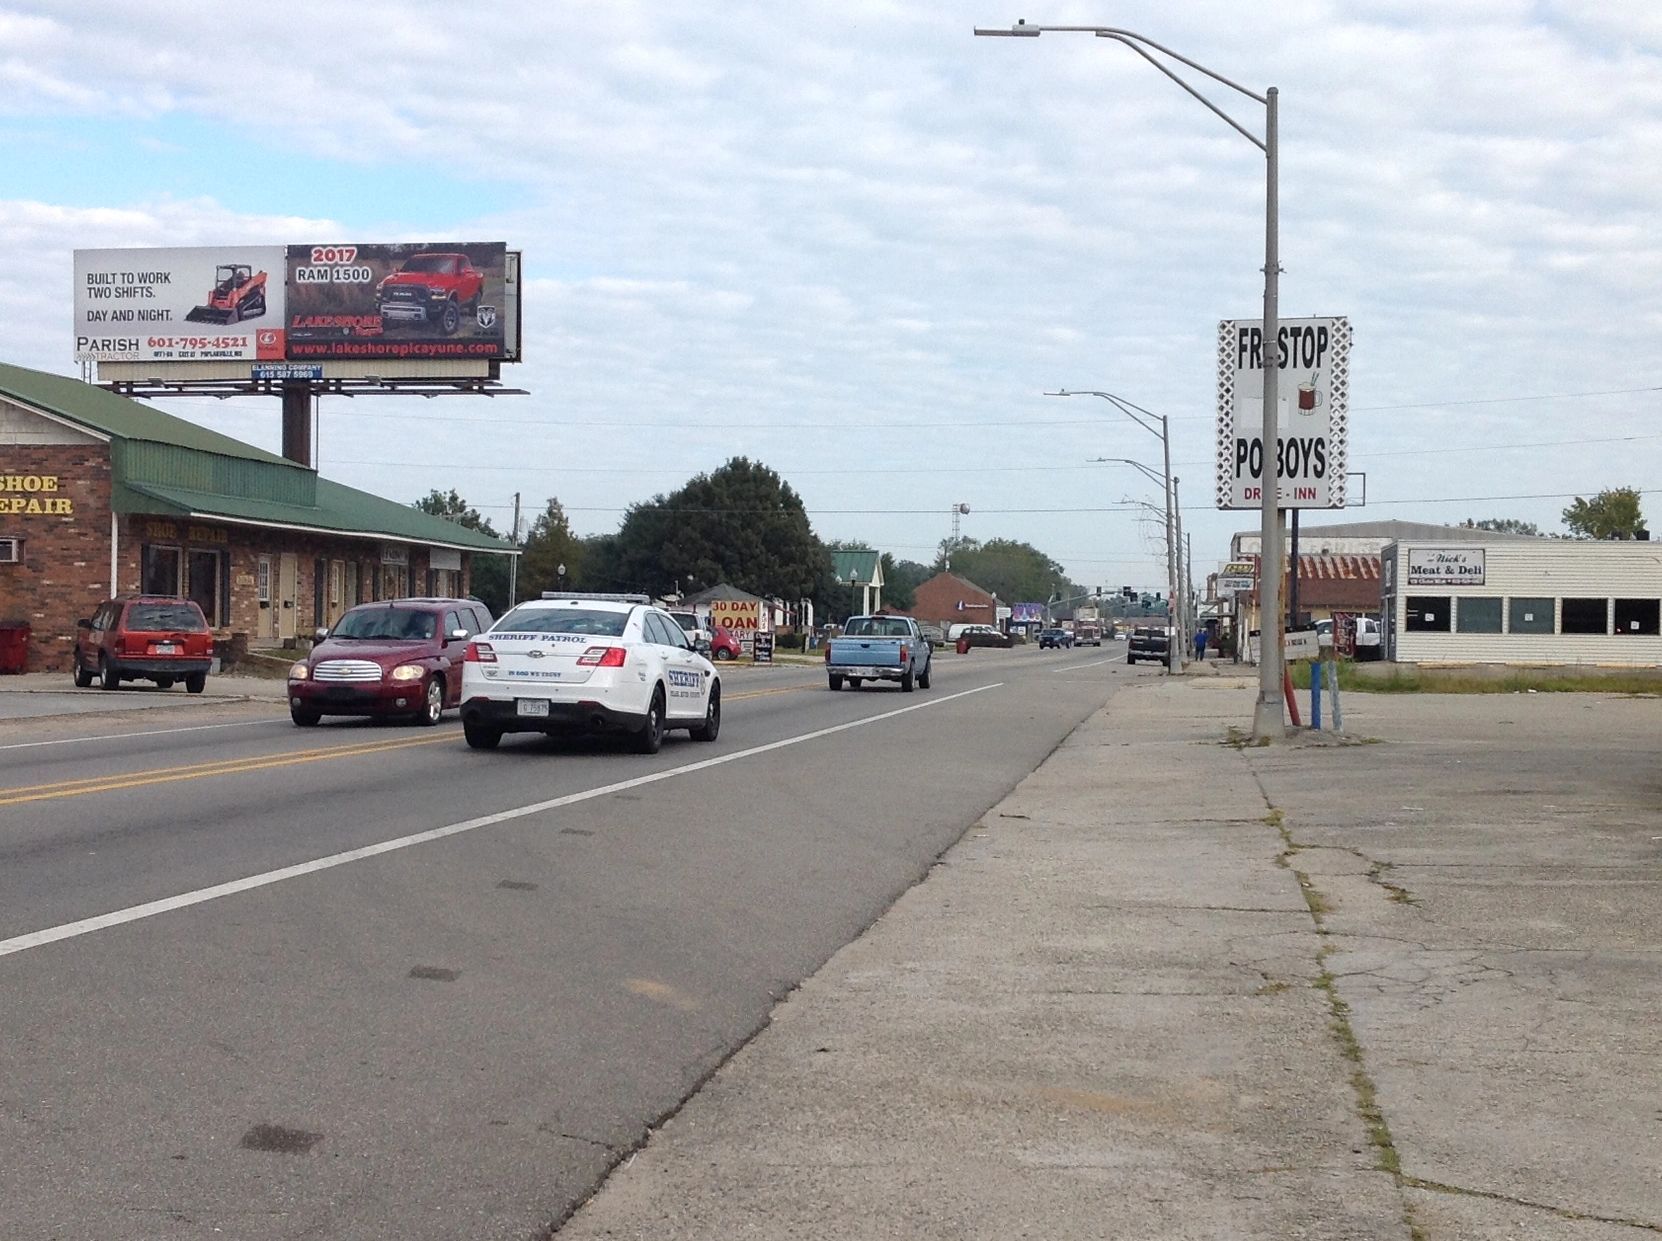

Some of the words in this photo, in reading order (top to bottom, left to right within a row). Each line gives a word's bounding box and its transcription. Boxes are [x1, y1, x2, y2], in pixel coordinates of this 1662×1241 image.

[312, 247, 357, 263] 2017
[87, 272, 117, 284] BUILT
[120, 272, 134, 284] TO
[138, 271, 171, 284] WORK
[297, 268, 329, 281] RAM
[334, 267, 371, 281] 1500
[87, 286, 112, 298] TWO
[114, 286, 156, 298] SHIFTS.
[87, 310, 108, 322] DAY
[111, 309, 134, 321] AND
[137, 309, 173, 321] NIGHT.
[77, 336, 140, 351] PARISH
[147, 336, 248, 350] 601-795-4521
[292, 342, 498, 356] www.lakeshorepicayune.com
[1238, 326, 1329, 369] FRSTOP
[96, 352, 140, 360] TRACTOR
[1244, 488, 1282, 500] DRE
[1294, 487, 1317, 500] INN
[1410, 565, 1441, 575] Meat
[1444, 565, 1455, 575] &
[1458, 565, 1482, 575] Deli
[712, 601, 727, 611] 30
[731, 601, 757, 611] DAY
[541, 634, 587, 643] PATROL
